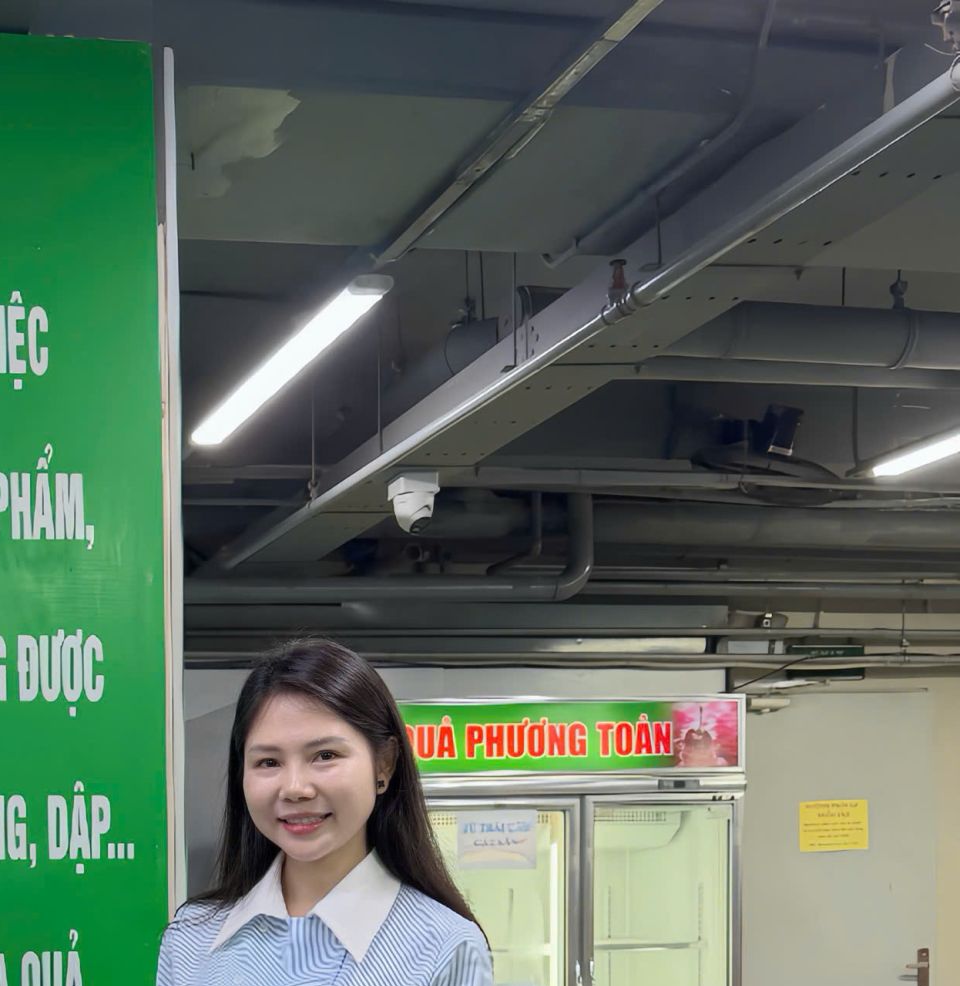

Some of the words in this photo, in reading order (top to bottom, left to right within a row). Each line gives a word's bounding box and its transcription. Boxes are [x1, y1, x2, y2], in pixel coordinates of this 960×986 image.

[16, 628, 105, 717] ĐƯỢC
[465, 717, 588, 759] PHƯƠNG
[47, 781, 135, 874] DẬP...
